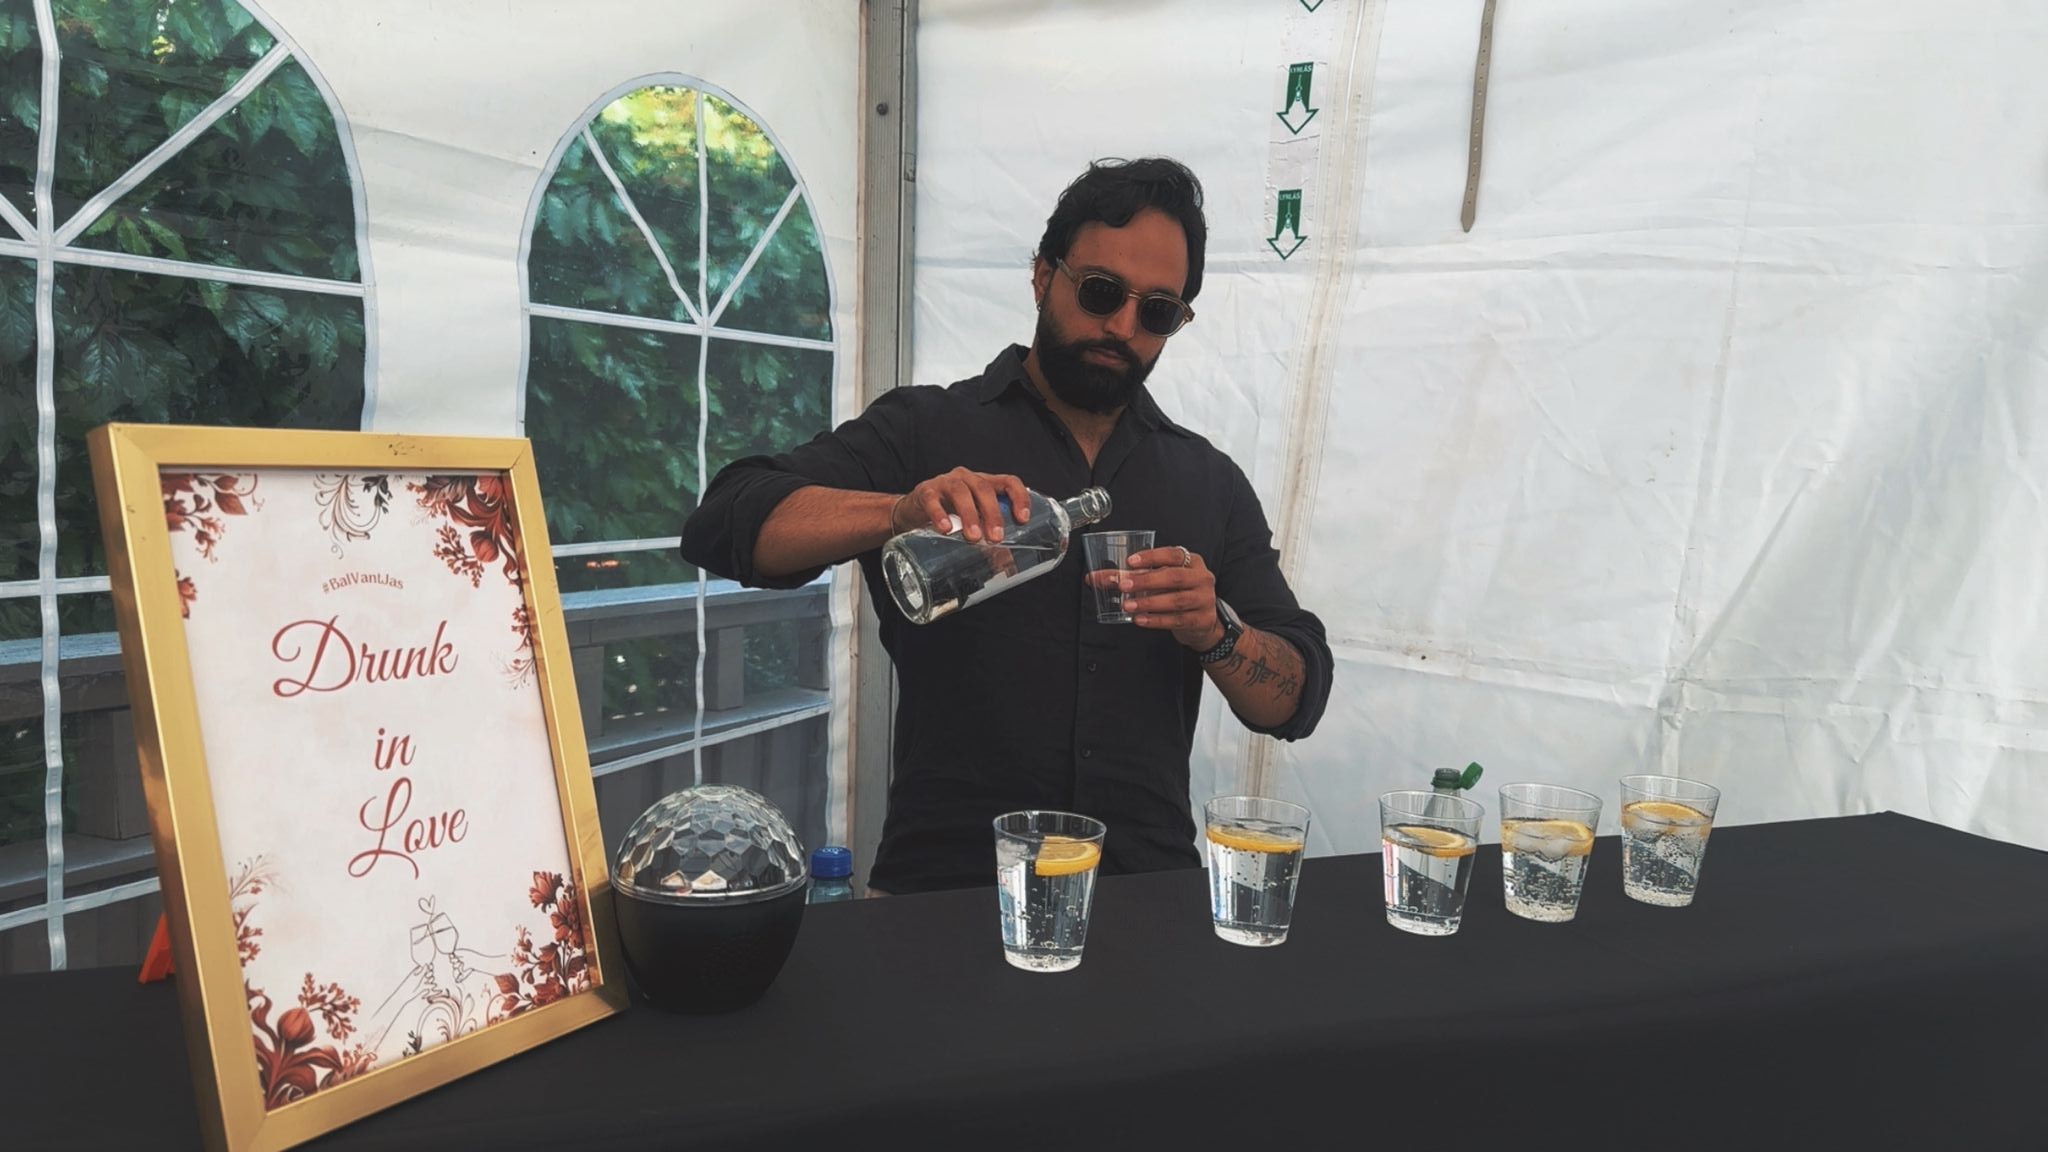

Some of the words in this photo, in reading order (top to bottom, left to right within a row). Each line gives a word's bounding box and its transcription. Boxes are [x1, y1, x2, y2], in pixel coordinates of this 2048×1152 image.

[322, 572, 404, 593] #BalVantJas
[272, 615, 459, 698] Drunk
[374, 727, 416, 771] in
[348, 776, 469, 880] Love
